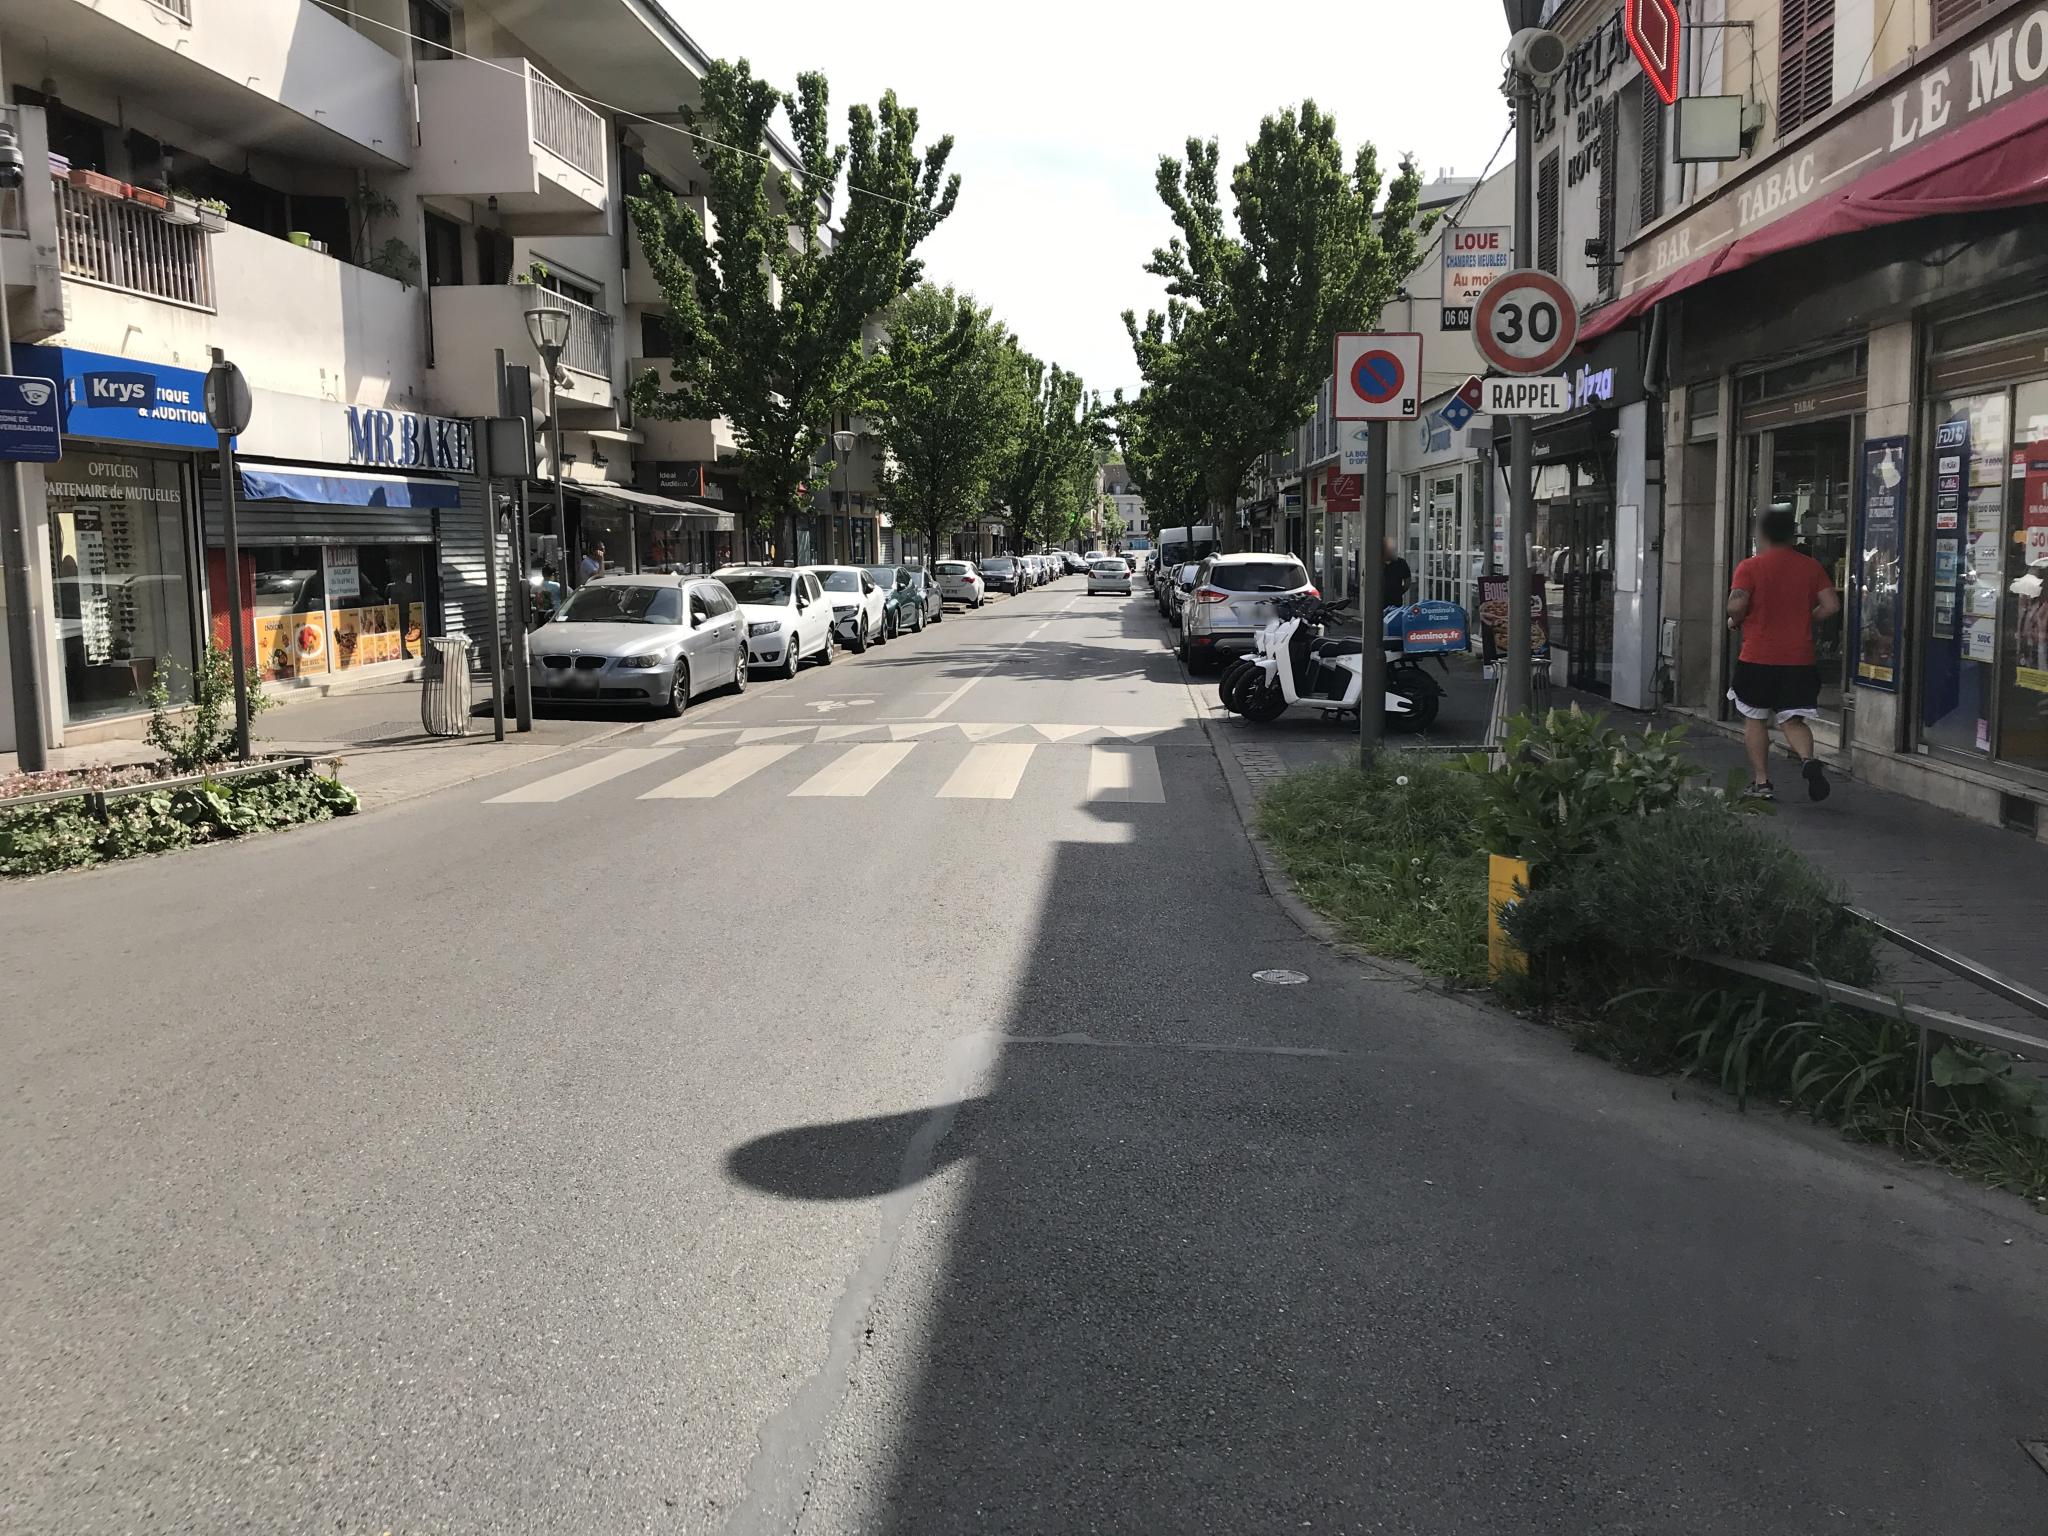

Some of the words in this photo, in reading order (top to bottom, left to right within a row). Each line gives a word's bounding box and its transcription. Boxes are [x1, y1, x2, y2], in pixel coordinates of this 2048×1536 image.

[1890, 67, 1951, 152] LE
[1968, 10, 2048, 112] MO
[1568, 135, 1601, 188] HOTE
[1656, 228, 1690, 271] BAR
[1737, 153, 1815, 228] TABAC
[1455, 233, 1499, 250] LOUE
[1446, 255, 1476, 268] CHAMBRES
[1453, 273, 1468, 287] Au
[1445, 310, 1456, 326] 06
[1458, 310, 1469, 326] 09
[1496, 301, 1557, 344] 30
[93, 377, 146, 402] Krys
[1575, 363, 1614, 408] Pizza
[156, 387, 190, 404] TIQUE
[1492, 383, 1560, 409] RAPPEL
[152, 406, 207, 424] AUDITION
[1938, 426, 1956, 444] FDJ
[1345, 450, 1354, 458] LA
[1355, 450, 1369, 458] BOU
[88, 462, 138, 479] OPTICIEN
[659, 471, 677, 479] Ideal
[44, 481, 108, 499] PARTENAIRE
[110, 482, 124, 499] de
[125, 485, 181, 503] MUTUELLES
[1421, 606, 1455, 614] Domino's
[1410, 631, 1459, 640] dominos.fr
